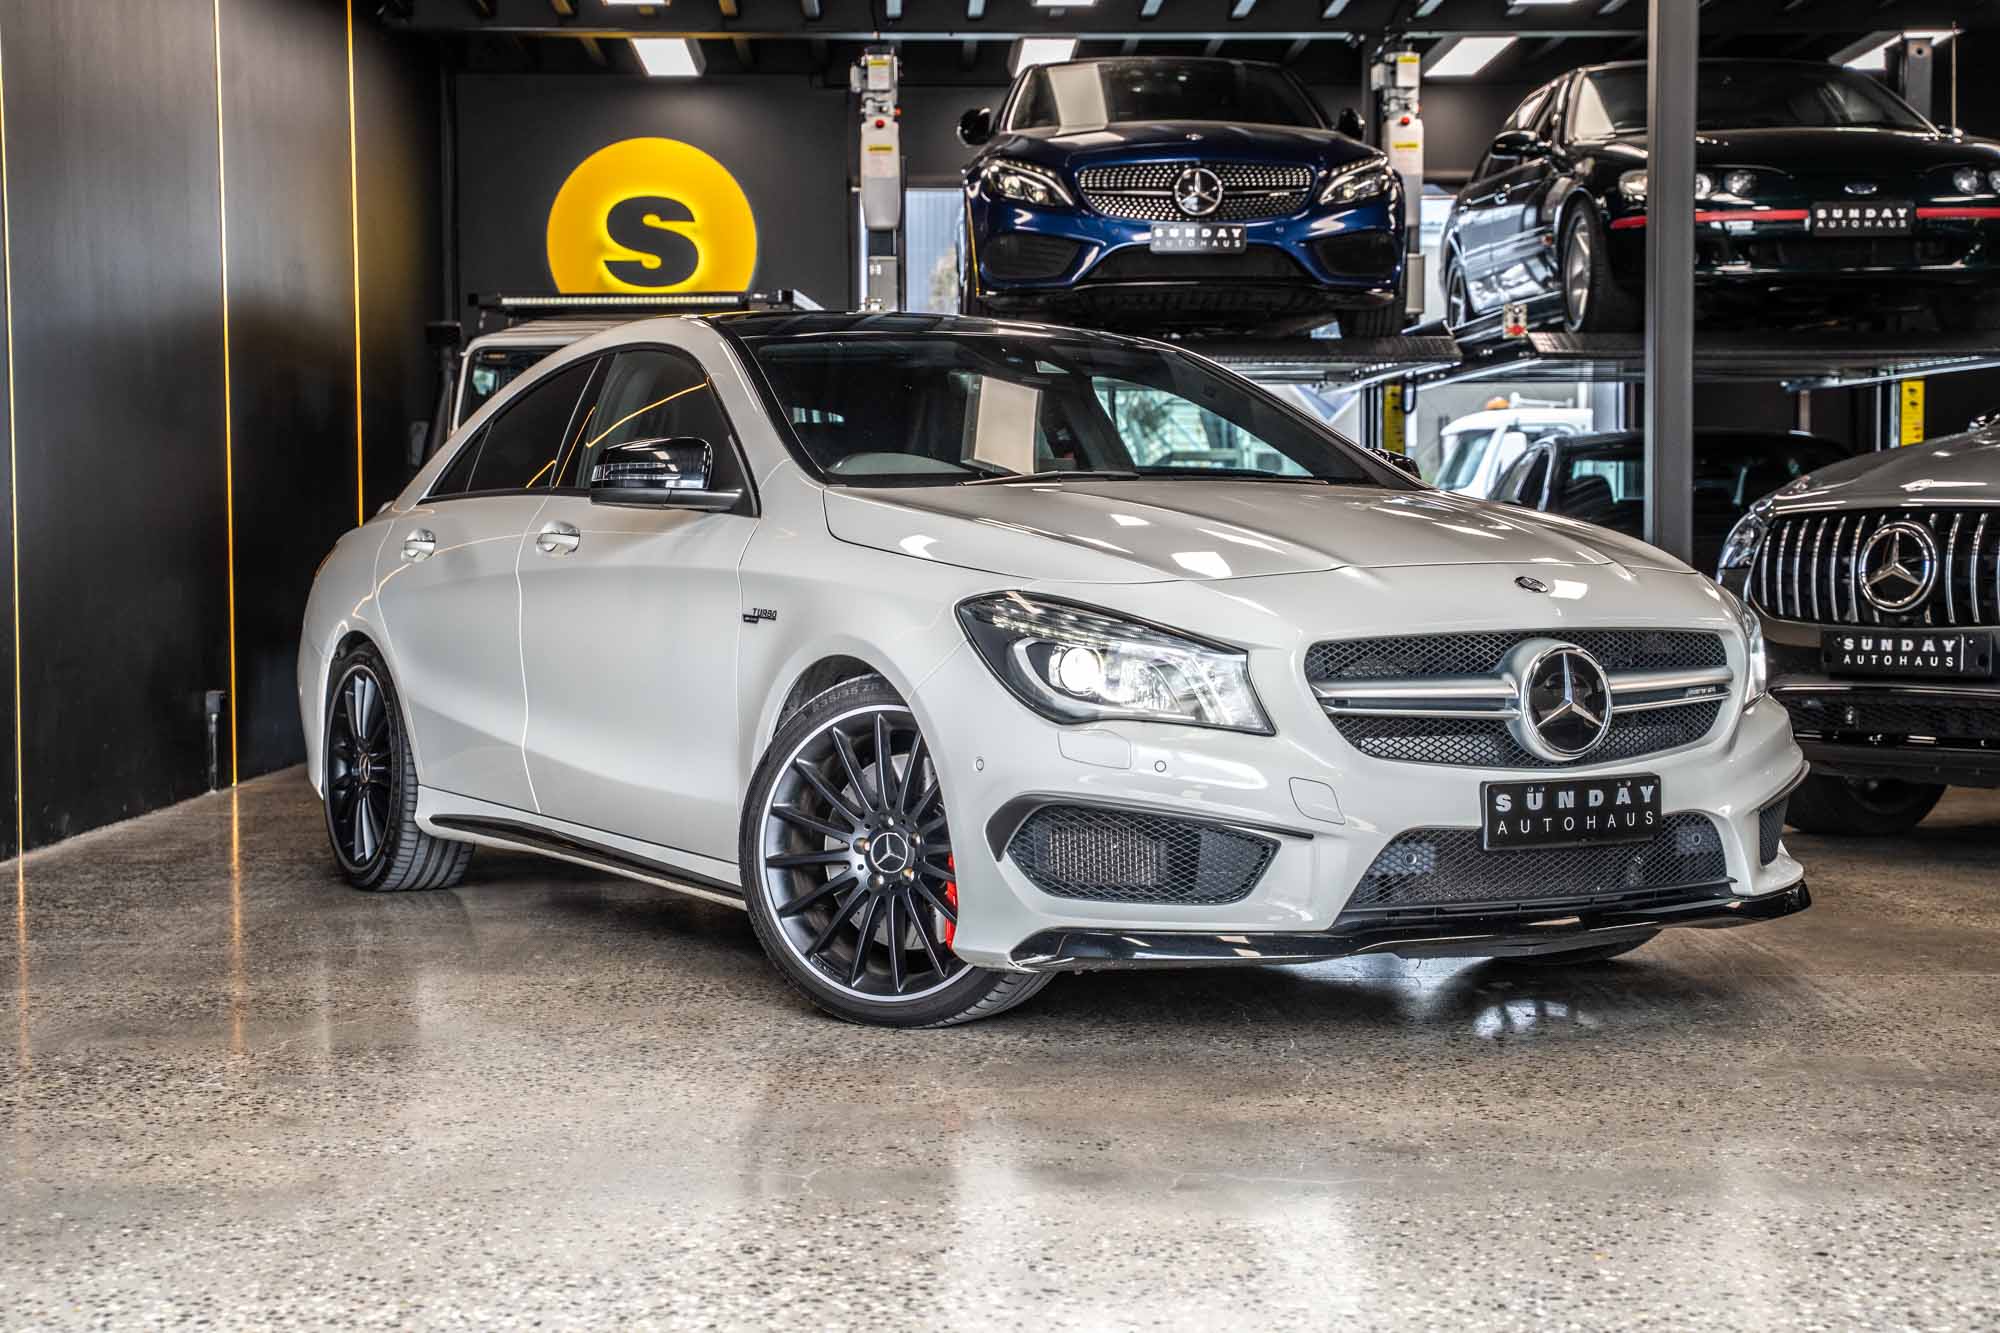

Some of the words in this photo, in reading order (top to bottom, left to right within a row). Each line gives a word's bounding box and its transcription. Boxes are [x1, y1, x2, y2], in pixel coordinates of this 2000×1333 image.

[1816, 207, 1908, 219] SUNDAY
[1816, 219, 1907, 229] AUTOHAUS
[1154, 228, 1242, 238] SUNDAY
[603, 196, 699, 287] S
[1843, 654, 1954, 667] AUTOHAUS
[1497, 810, 1654, 835] AUTOHAUS
